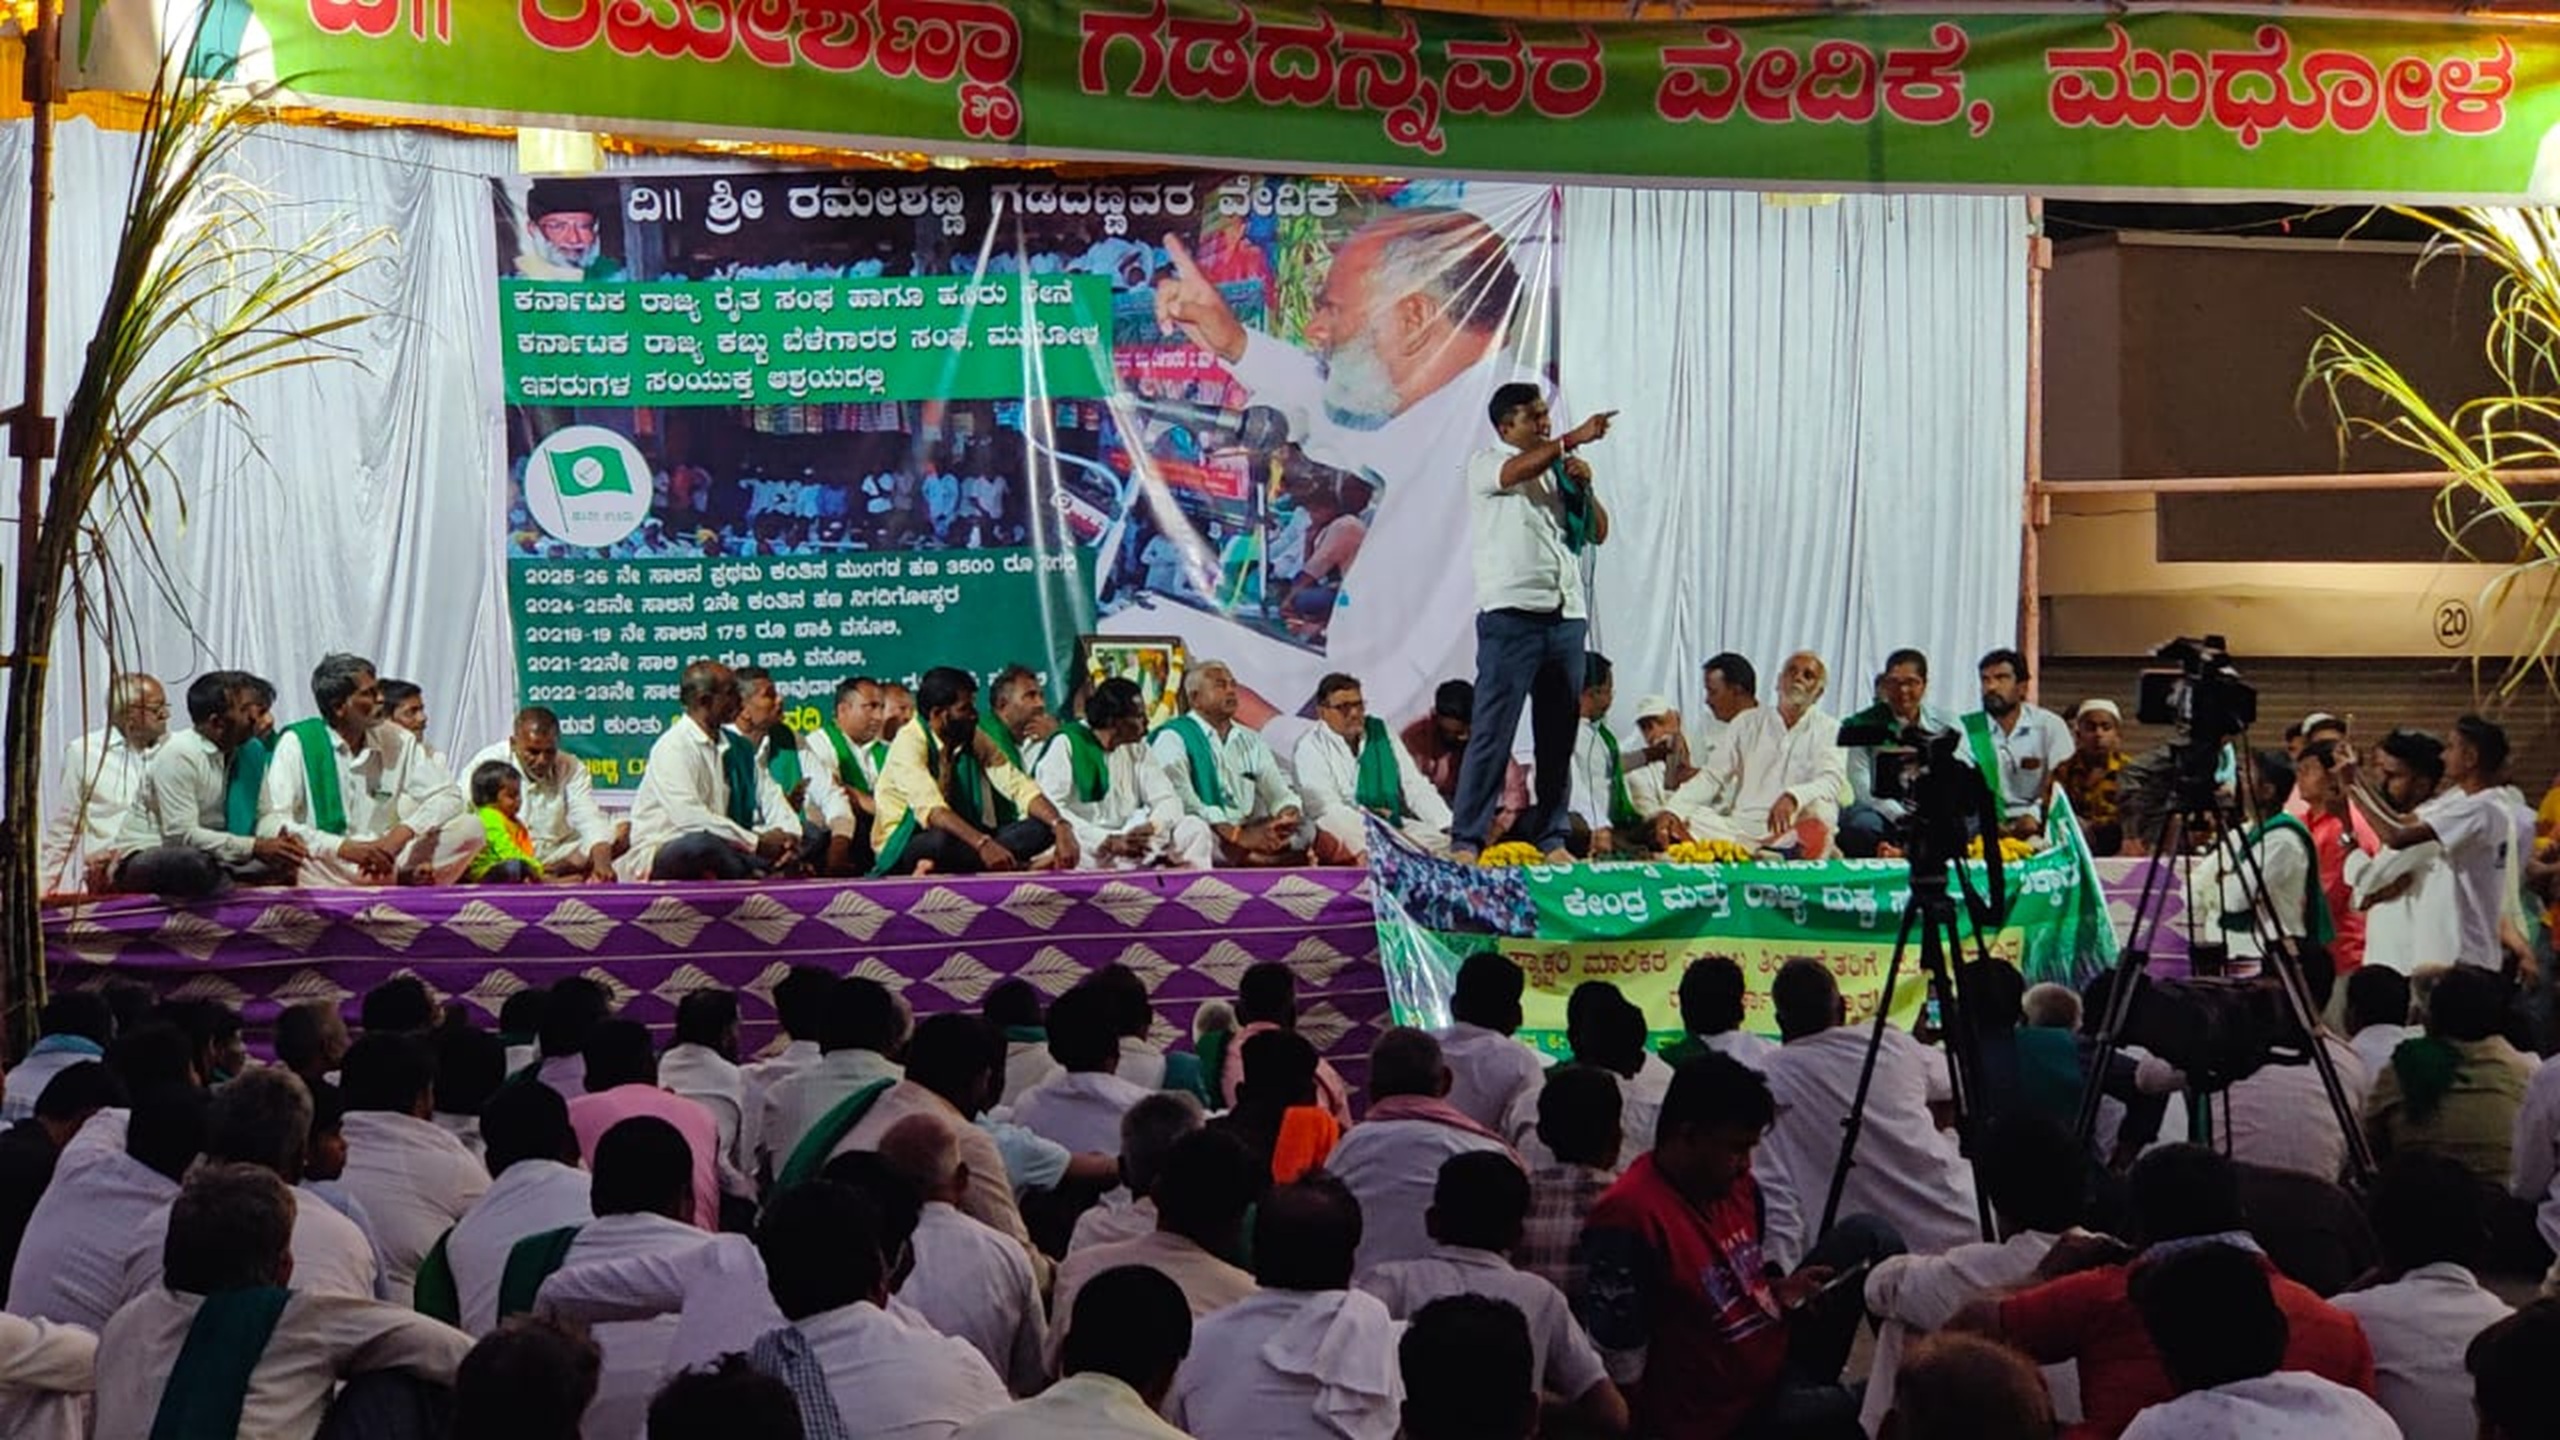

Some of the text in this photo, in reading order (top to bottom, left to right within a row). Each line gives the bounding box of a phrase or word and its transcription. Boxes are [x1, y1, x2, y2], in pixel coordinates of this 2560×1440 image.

[1657, 22, 1994, 137] ವೇದಿಕೆ,
[2047, 22, 2516, 148] ಮುಧೋಳ
[704, 180, 765, 234] ಶ್ರೀ
[788, 177, 966, 236] ರಮೇಶಣ್ಣ
[513, 288, 626, 312] ಕರ್ನಾಟಕ
[640, 290, 702, 323] ರಾಜ್ಯ
[715, 286, 761, 323] ರೈತ
[775, 285, 835, 313] ಸಂಘ
[848, 285, 925, 308] ಹಾಗೂ
[517, 330, 630, 354] ಕರ್ನಾಟಕ
[644, 333, 705, 365] ರಾಜ್ಯ
[716, 330, 770, 365] ಕಬ್ಬು
[782, 325, 898, 353] ಬೆಳೆಗಾರರ
[520, 372, 631, 397] ಇವರುಗಳ
[645, 368, 755, 399] ಸಂಯುಕ್ತ
[525, 568, 609, 585] 2025-26
[616, 563, 641, 585] ನೇ
[710, 564, 763, 588] ಪ್ರಥಮ
[770, 562, 828, 580] ಕಂತಿನ
[946, 559, 995, 576] 3500
[747, 589, 806, 611] ಕಂತಿನ
[620, 622, 646, 643] ನೇ
[716, 624, 747, 640] 175
[2441, 607, 2467, 636] 20
[1563, 886, 1649, 923] ಕೇಂದ್ರ
[1660, 877, 1731, 919] ಮತ್ತು
